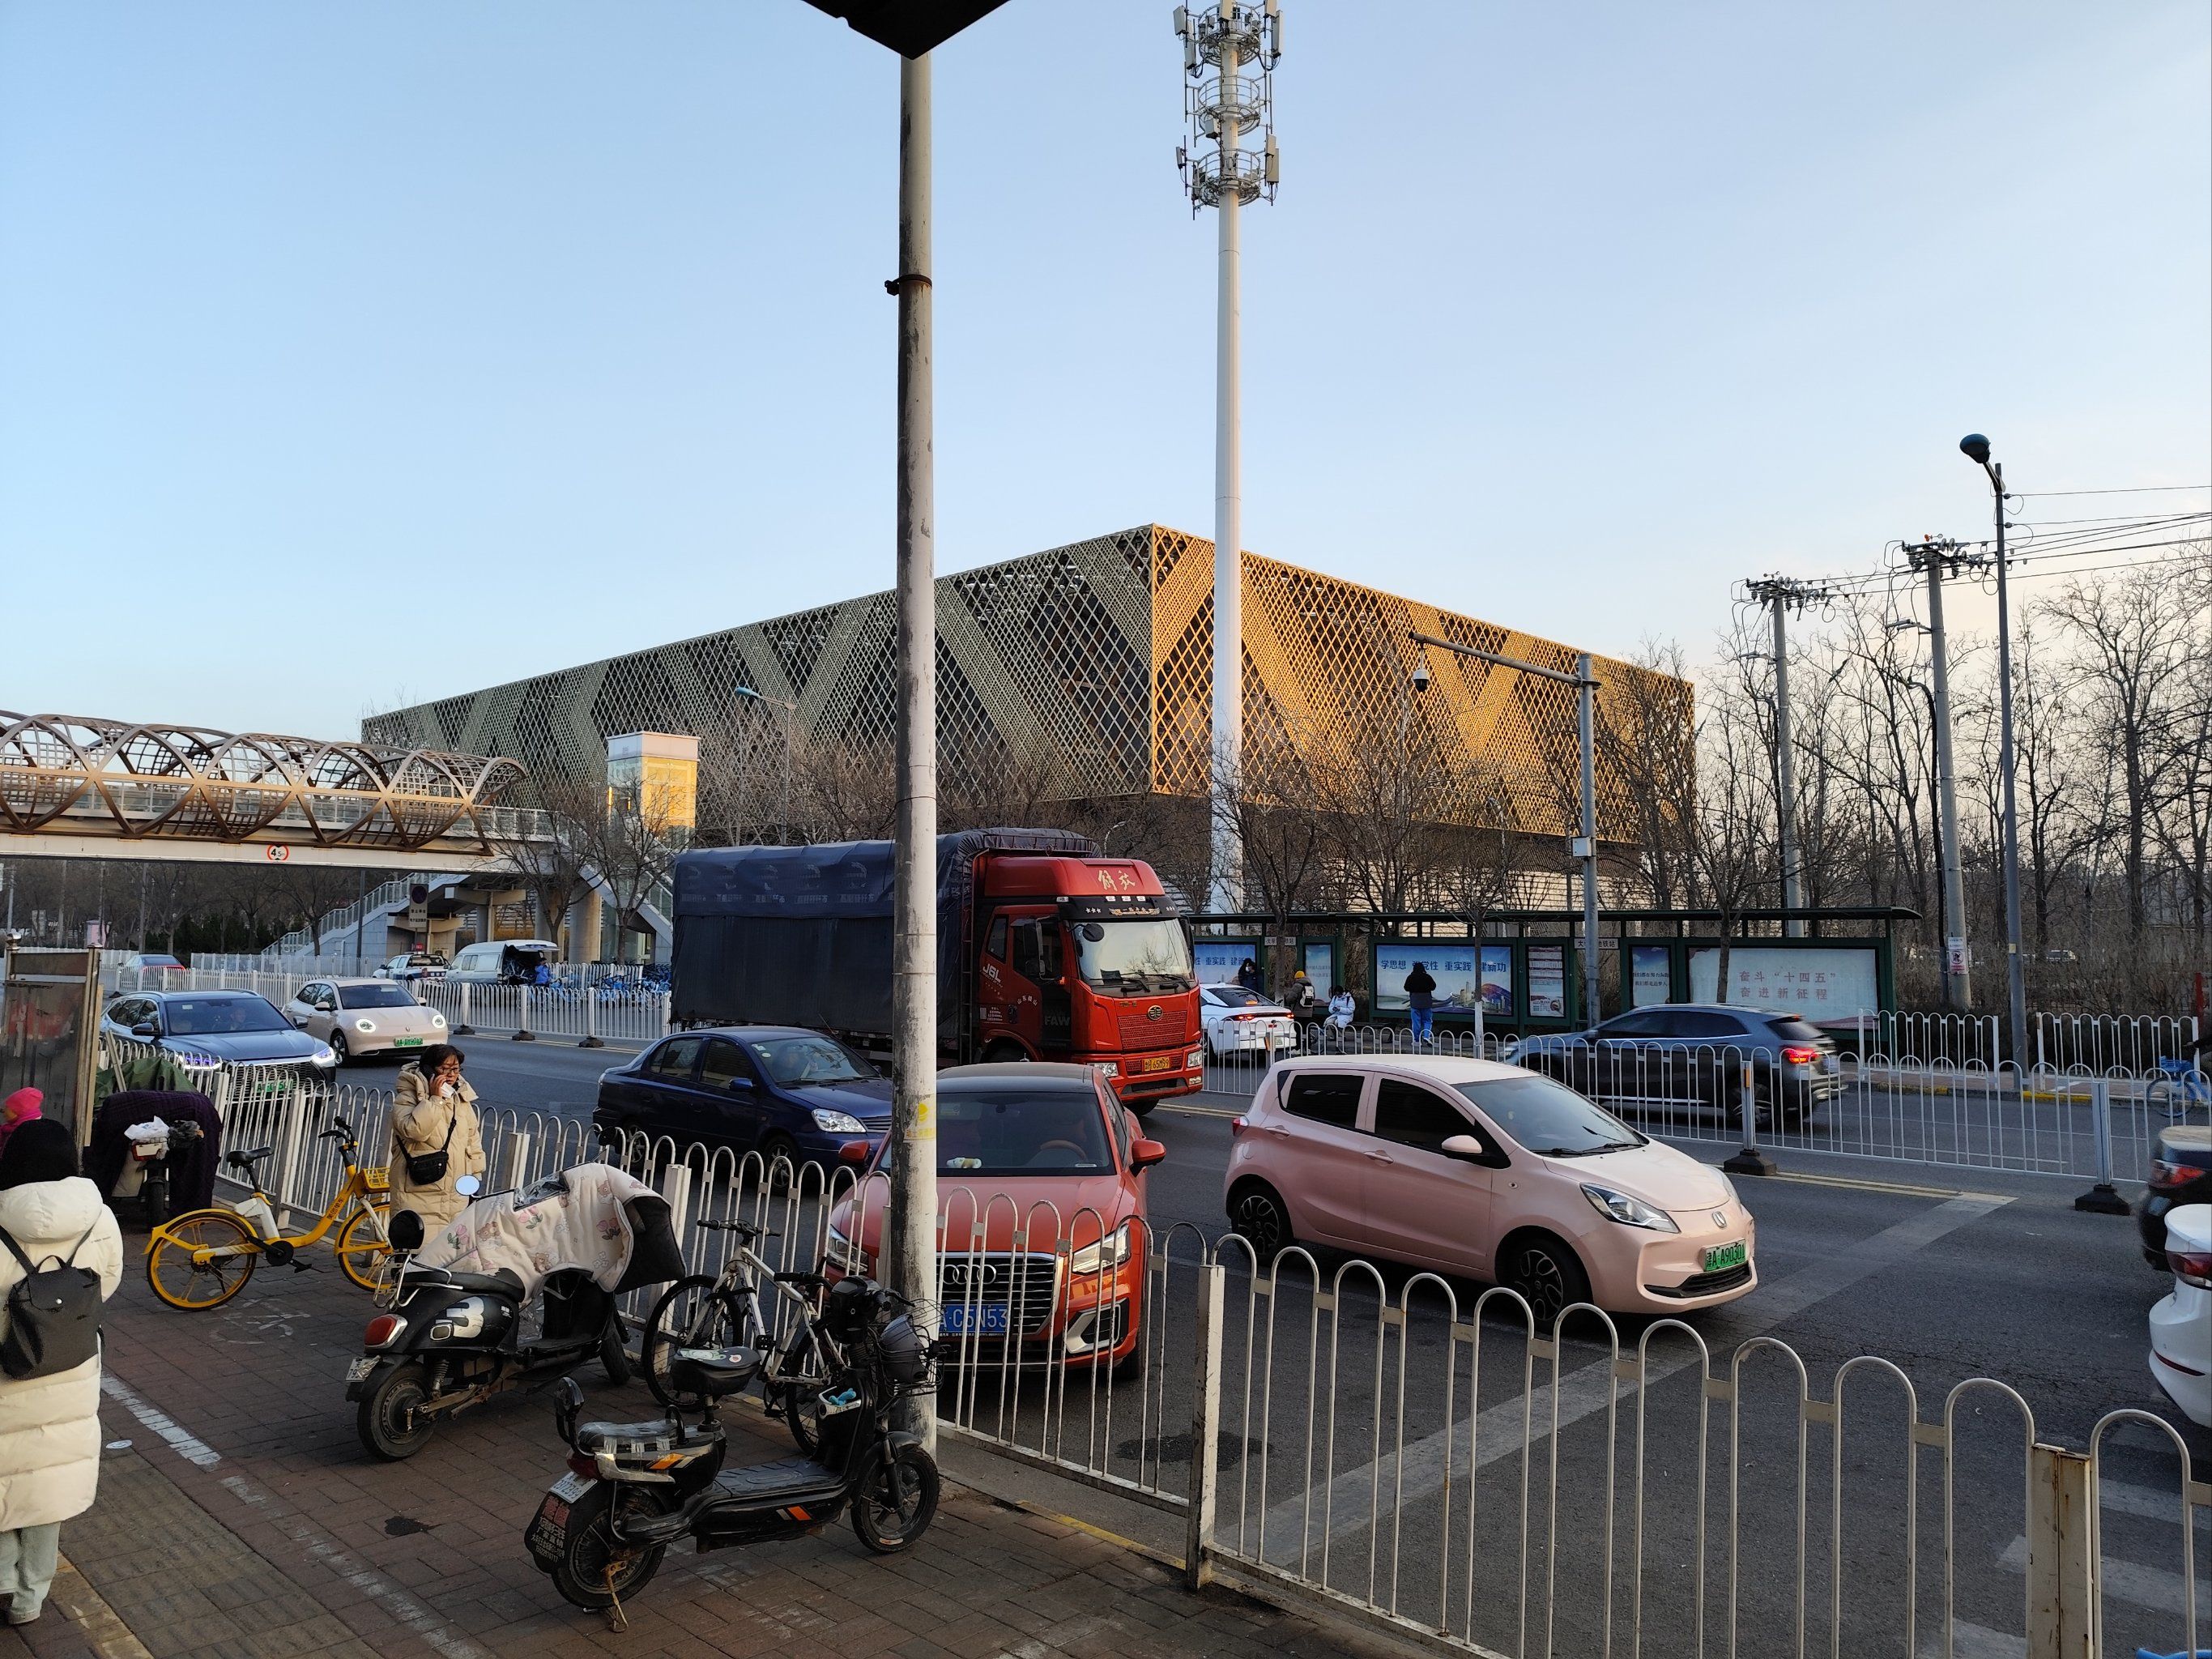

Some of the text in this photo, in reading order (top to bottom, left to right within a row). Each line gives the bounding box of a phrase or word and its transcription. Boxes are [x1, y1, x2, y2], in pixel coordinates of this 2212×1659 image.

[1381, 960, 1407, 970] 学思想
[1445, 962, 1472, 972] 重实践
[1740, 987, 1828, 1000] 奋进新征程
[1044, 1015, 1070, 1026] FAW
[940, 1308, 1009, 1328] A·C5N53
